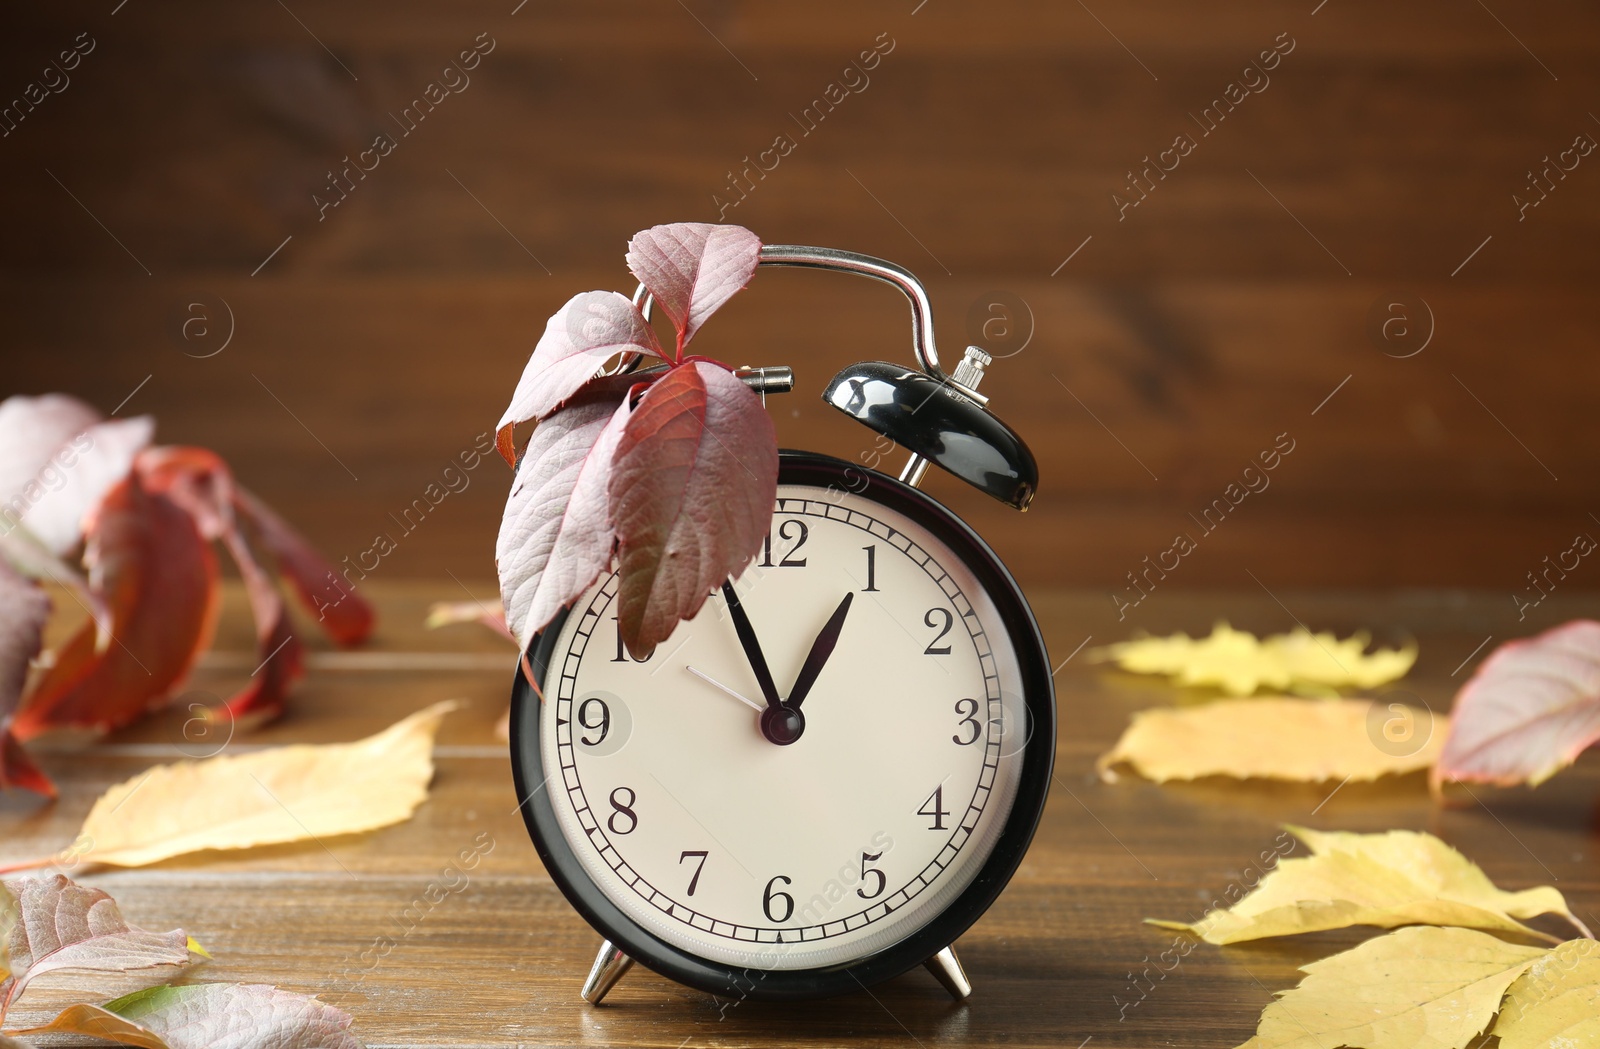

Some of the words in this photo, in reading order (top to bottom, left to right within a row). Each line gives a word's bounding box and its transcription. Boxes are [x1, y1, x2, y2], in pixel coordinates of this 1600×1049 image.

[757, 519, 809, 568] 12
[861, 544, 881, 592] 1
[609, 616, 657, 663] 1
[924, 608, 953, 655] 2
[578, 697, 610, 746] 9
[952, 698, 982, 746] 3
[607, 786, 639, 835] 8
[916, 785, 951, 831] 4
[679, 850, 709, 898] 7
[856, 851, 887, 899] 5
[762, 875, 795, 923] 6
